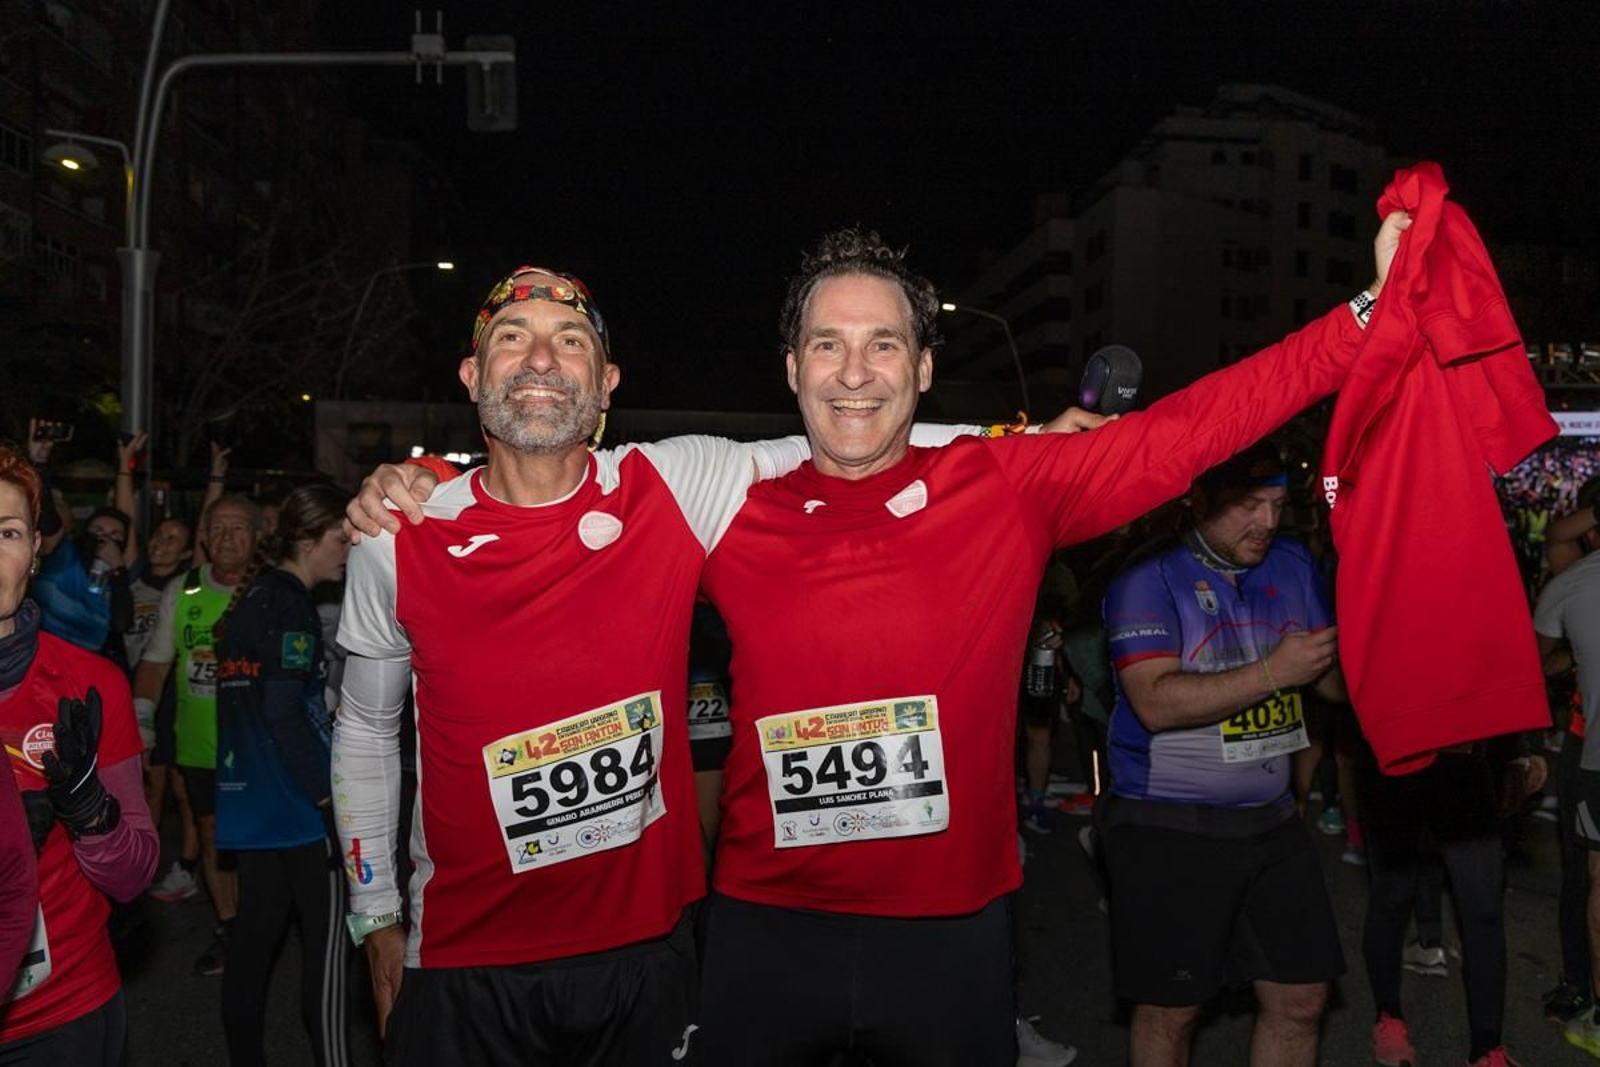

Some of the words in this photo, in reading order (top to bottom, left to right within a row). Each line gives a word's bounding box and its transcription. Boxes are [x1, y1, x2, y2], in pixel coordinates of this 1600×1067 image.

[192, 661, 217, 679] 75
[1229, 692, 1296, 731] 4031
[560, 734, 584, 749] SAN
[584, 722, 623, 741] ANTON
[794, 716, 826, 741] 42
[827, 724, 850, 737] SAN
[524, 733, 561, 760] 42
[511, 733, 655, 818] 5984
[782, 734, 929, 797] 5494
[546, 813, 577, 827] GENARO
[579, 798, 624, 817] ARAMBERRI
[818, 797, 835, 806] LUIS
[836, 793, 867, 804] SANCHEZ
